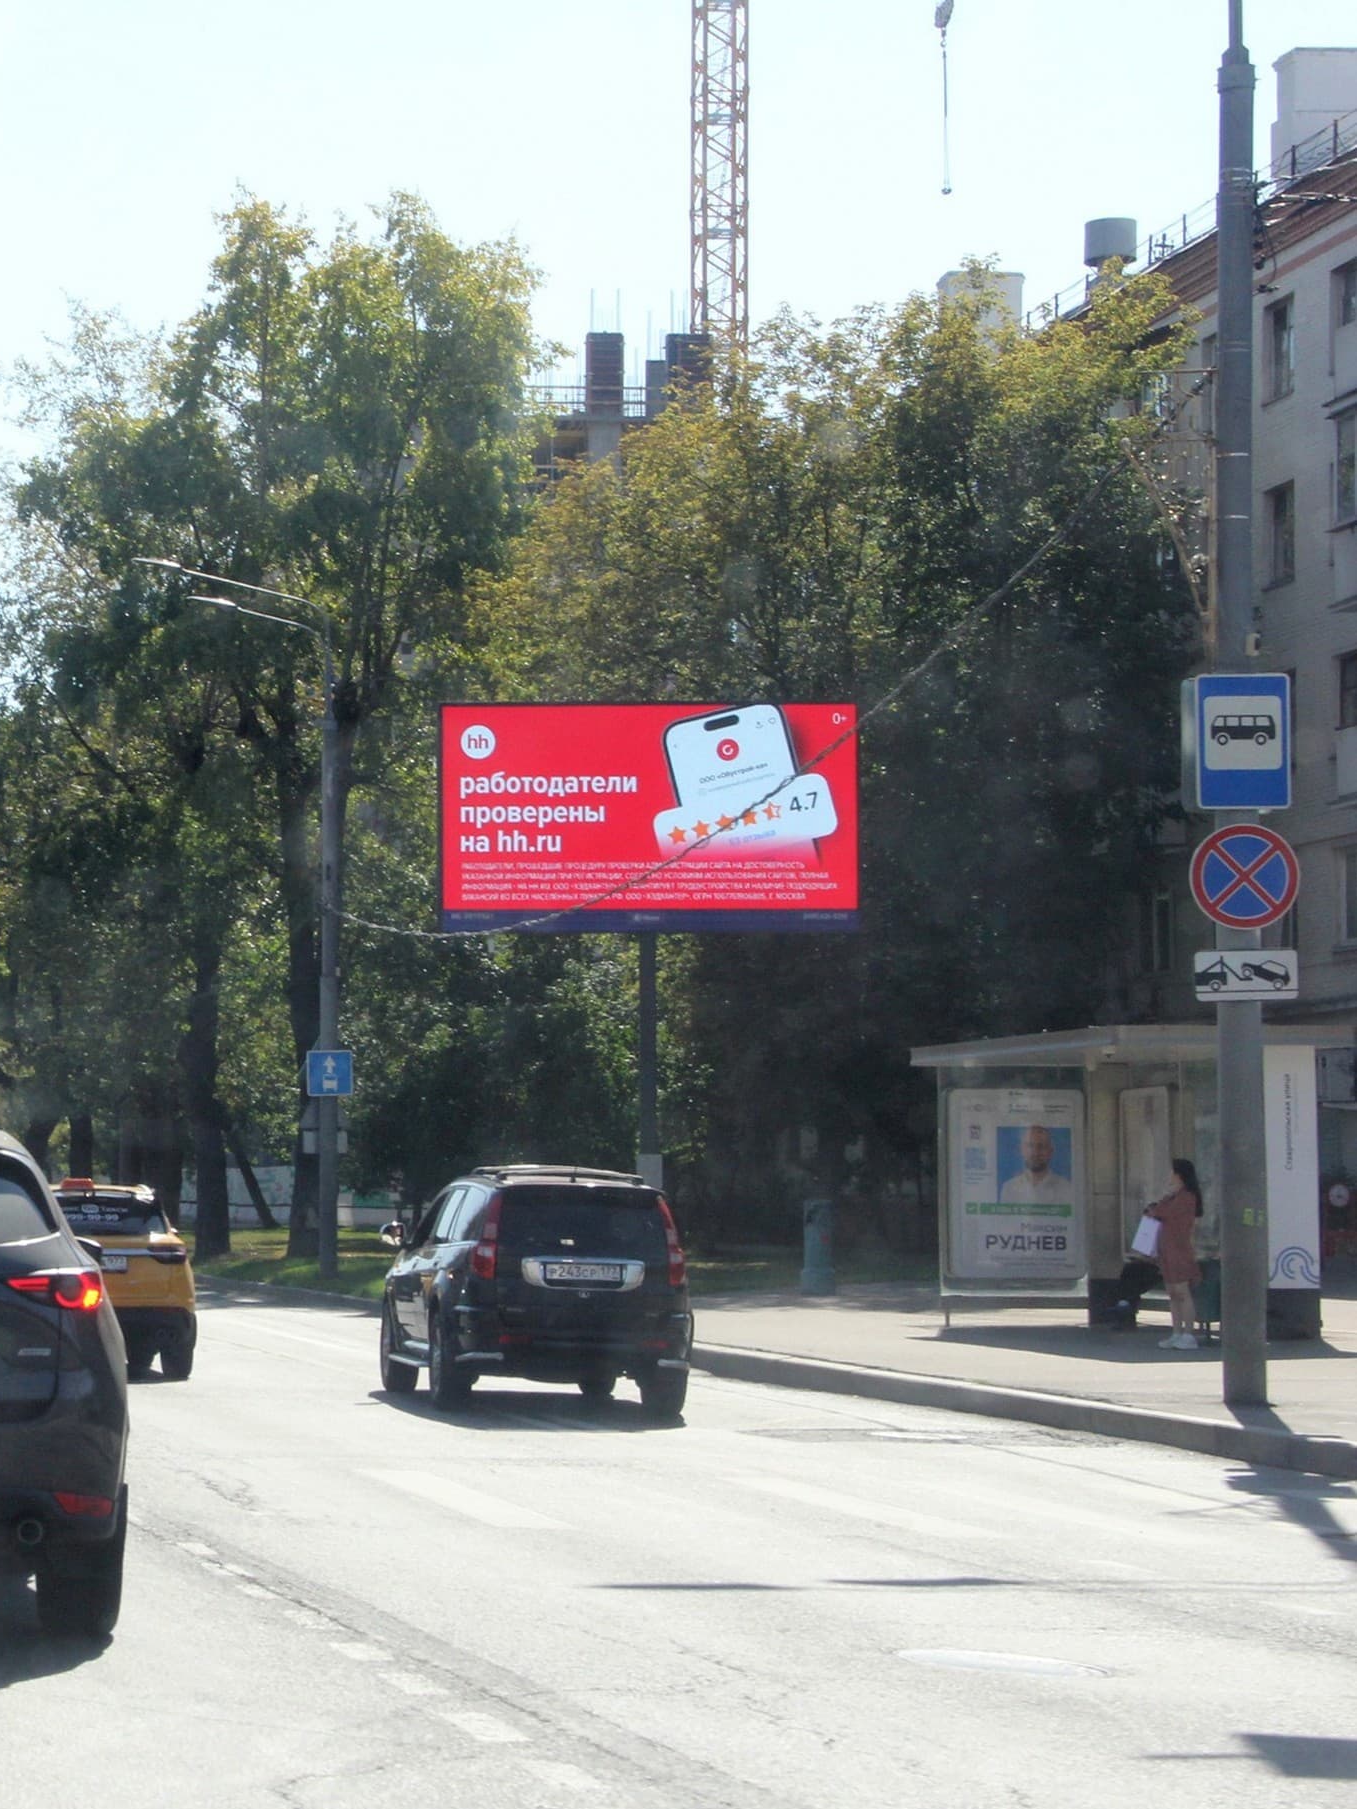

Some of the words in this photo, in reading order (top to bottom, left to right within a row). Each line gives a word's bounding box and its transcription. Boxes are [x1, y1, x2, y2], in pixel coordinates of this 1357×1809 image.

[832, 712, 848, 725] 0+
[467, 734, 489, 749] hh
[460, 771, 638, 799] работодатели
[789, 791, 818, 812] 4.7
[460, 805, 606, 828] проверены
[460, 835, 490, 852] на
[497, 830, 562, 852] hh.ru
[985, 1234, 1067, 1251] РУДНЕВ
